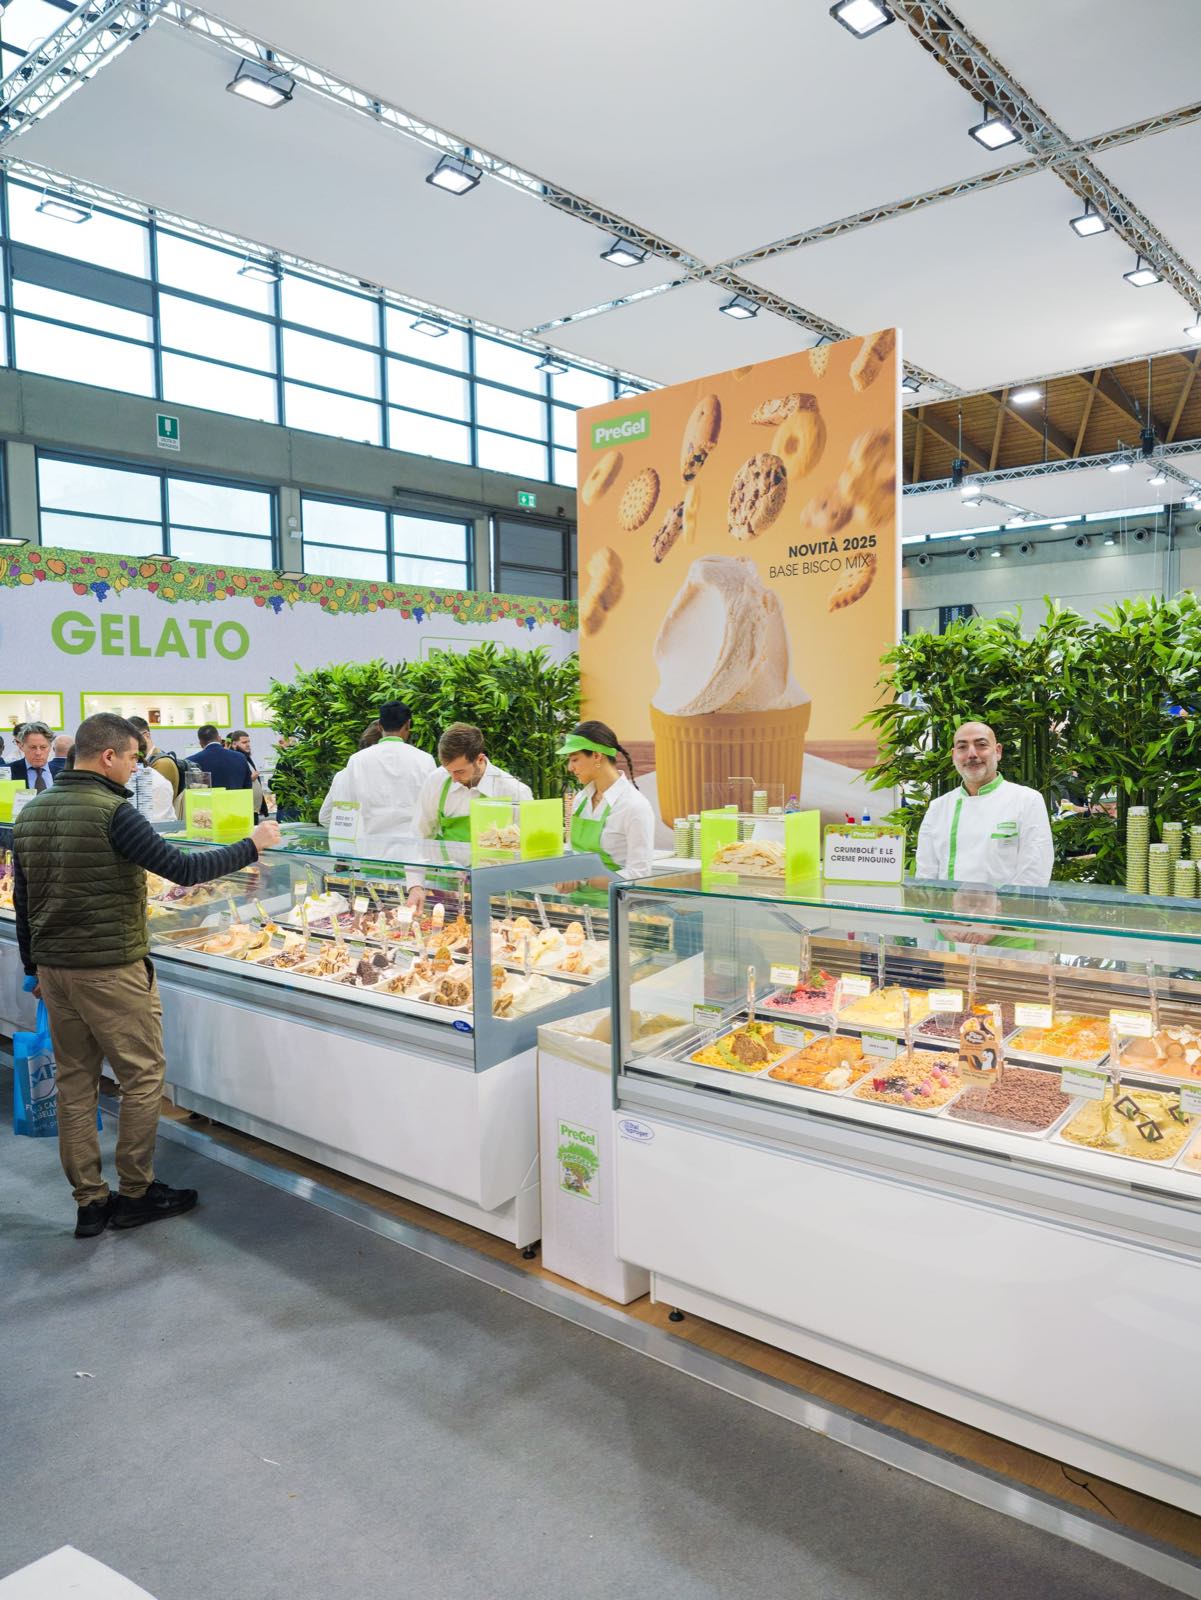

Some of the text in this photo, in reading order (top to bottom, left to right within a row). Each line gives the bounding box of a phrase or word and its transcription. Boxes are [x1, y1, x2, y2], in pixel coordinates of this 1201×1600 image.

[595, 417, 645, 443] PreGel
[788, 534, 877, 558] NOVITÀ 2025
[769, 563, 799, 579] BASE
[802, 558, 842, 575] BISCO
[51, 610, 250, 661] GELATO
[830, 855, 896, 864] CREME PINGUINO
[560, 1124, 595, 1146] PreGel
